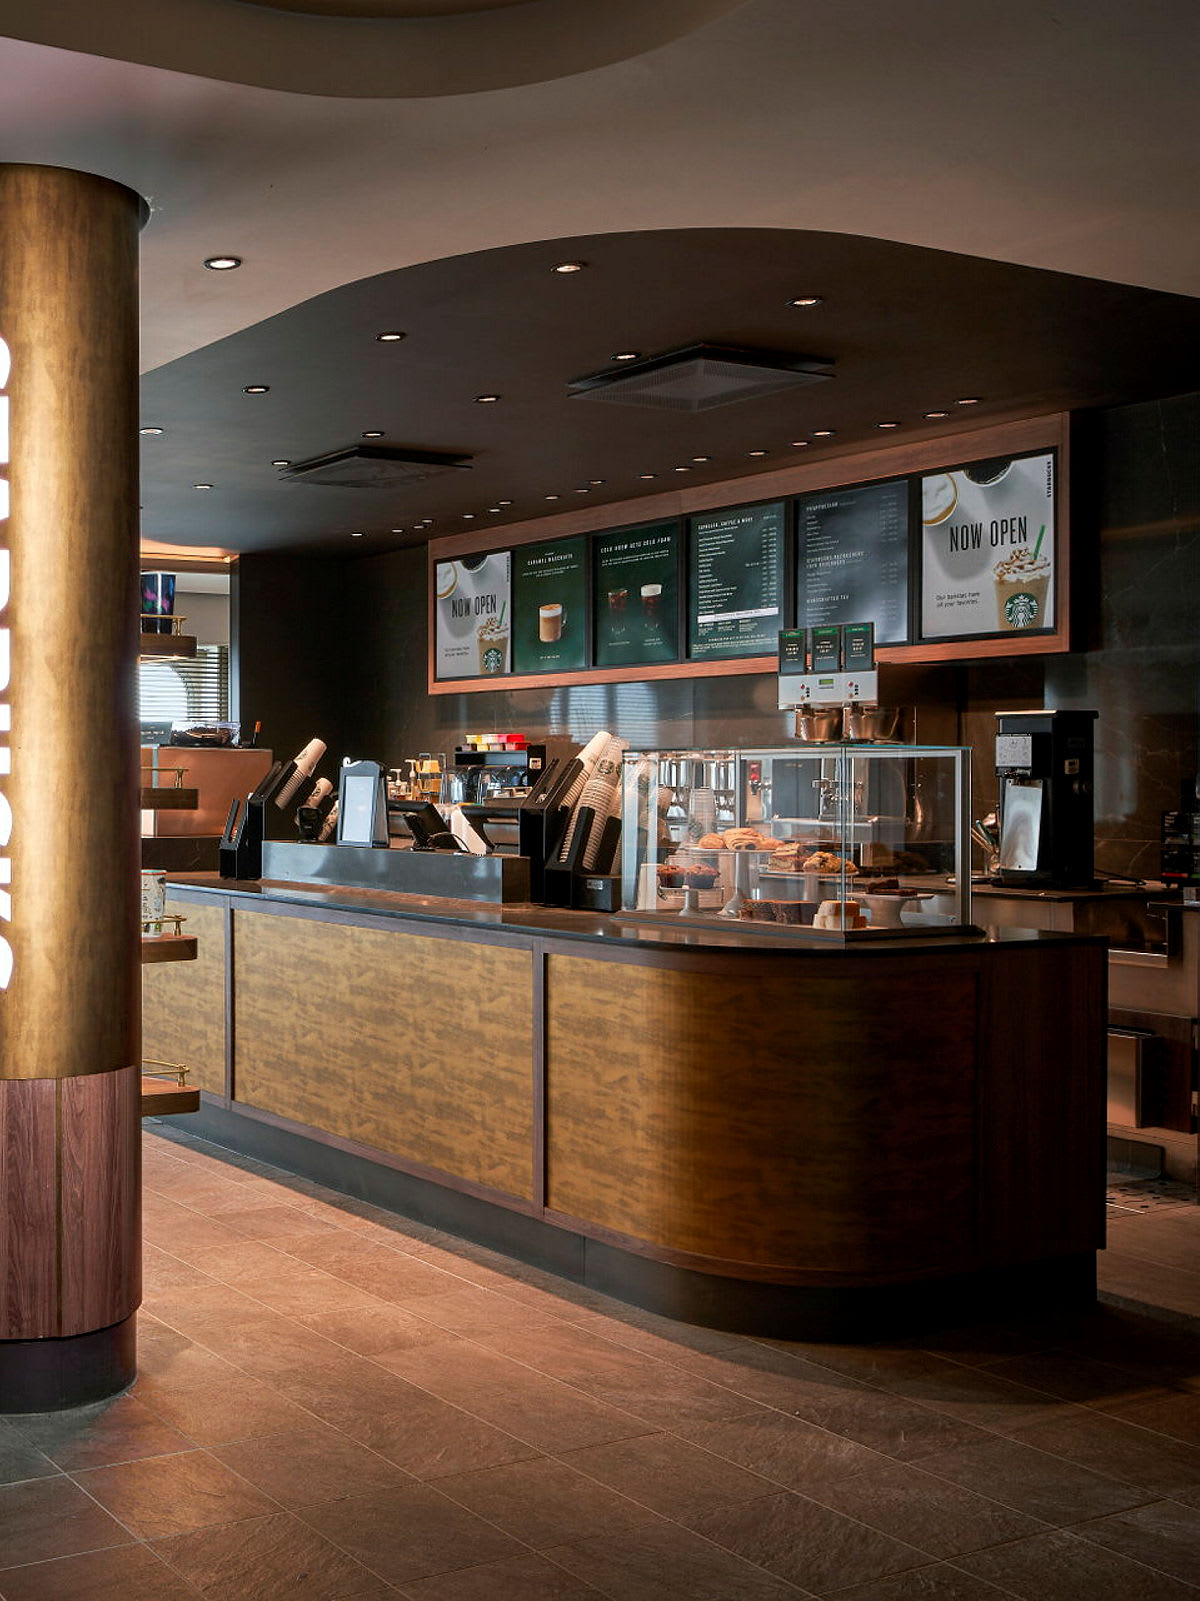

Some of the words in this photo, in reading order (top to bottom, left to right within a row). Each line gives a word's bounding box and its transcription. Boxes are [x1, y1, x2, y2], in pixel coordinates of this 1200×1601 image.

[950, 522, 983, 552] NOW
[990, 516, 1027, 547] OPEN
[451, 598, 472, 618] NOW
[474, 594, 497, 616] OPEN
